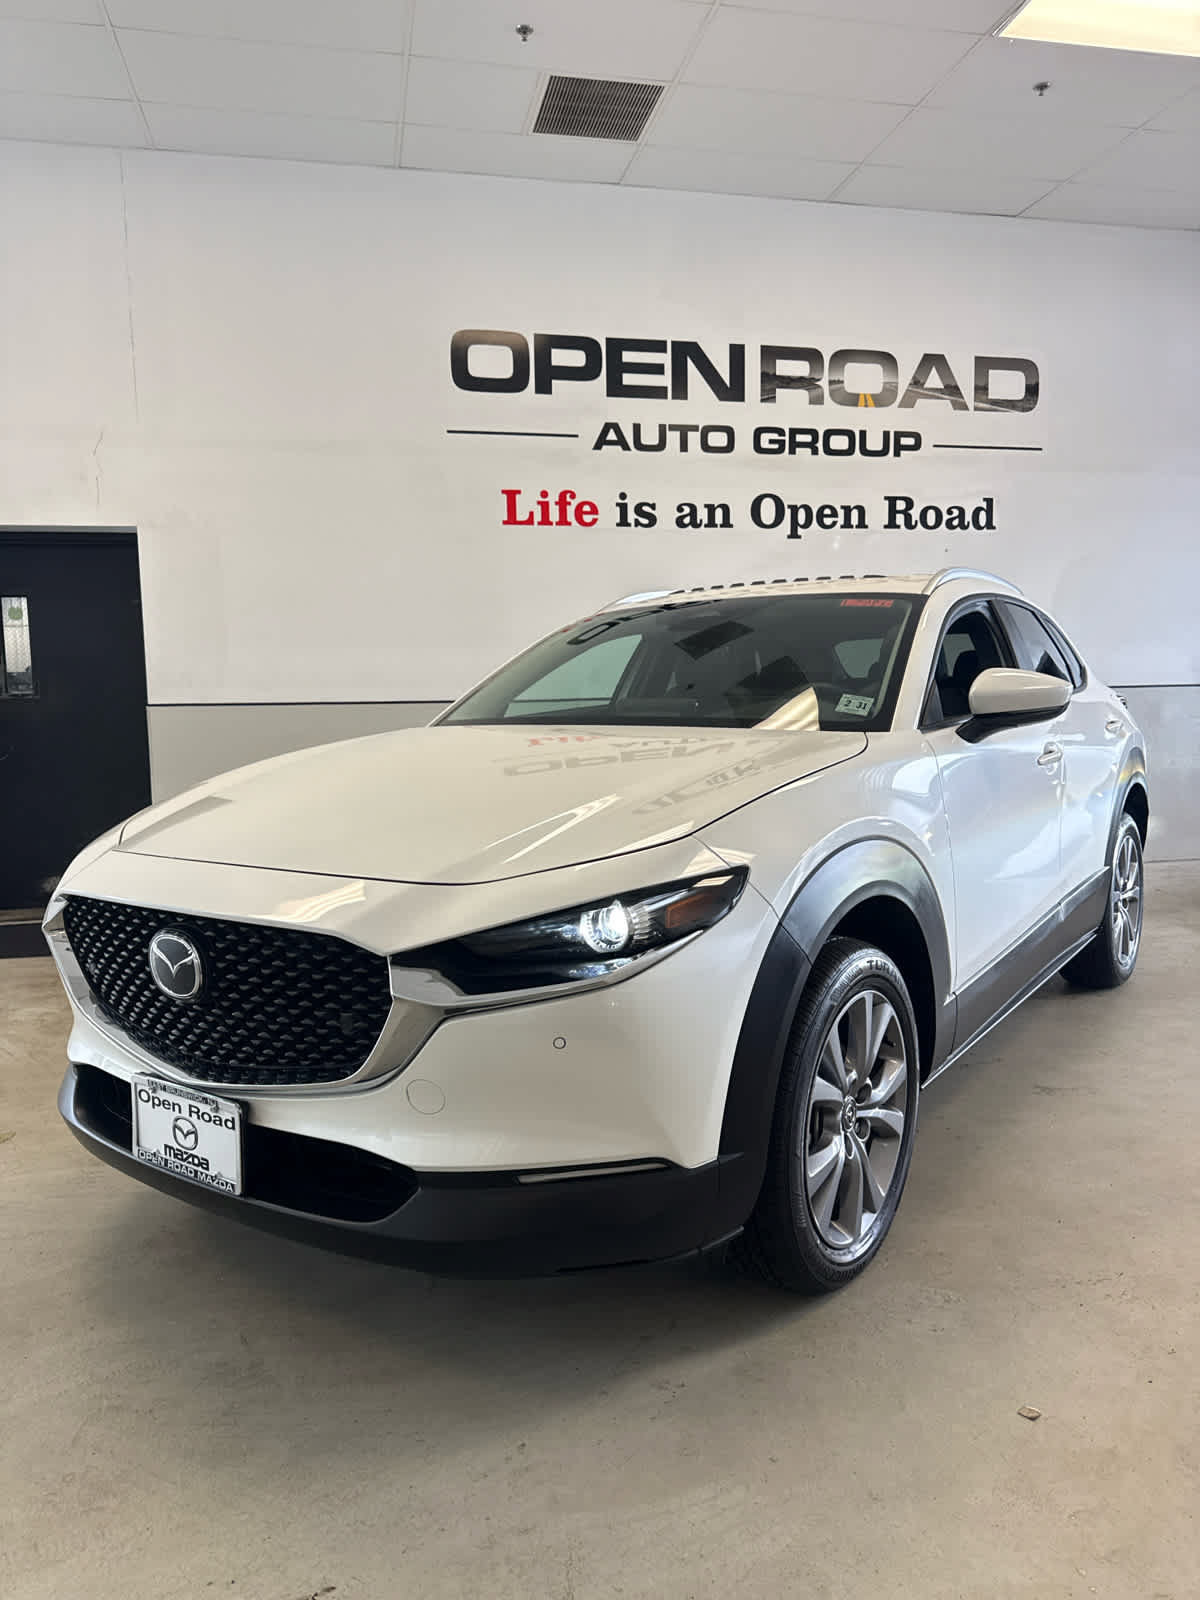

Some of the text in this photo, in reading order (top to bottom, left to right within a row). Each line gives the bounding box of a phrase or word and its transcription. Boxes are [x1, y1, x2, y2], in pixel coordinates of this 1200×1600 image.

[450, 328, 1040, 413] OPEN ROAD
[592, 421, 923, 458] AUTO GROUP
[501, 489, 997, 539] Life is an Open Road
[138, 1089, 182, 1115] Open
[188, 1104, 236, 1131] Road
[139, 1149, 234, 1193] OPEN ROAD MAZDA
[163, 1144, 210, 1172] mazda
